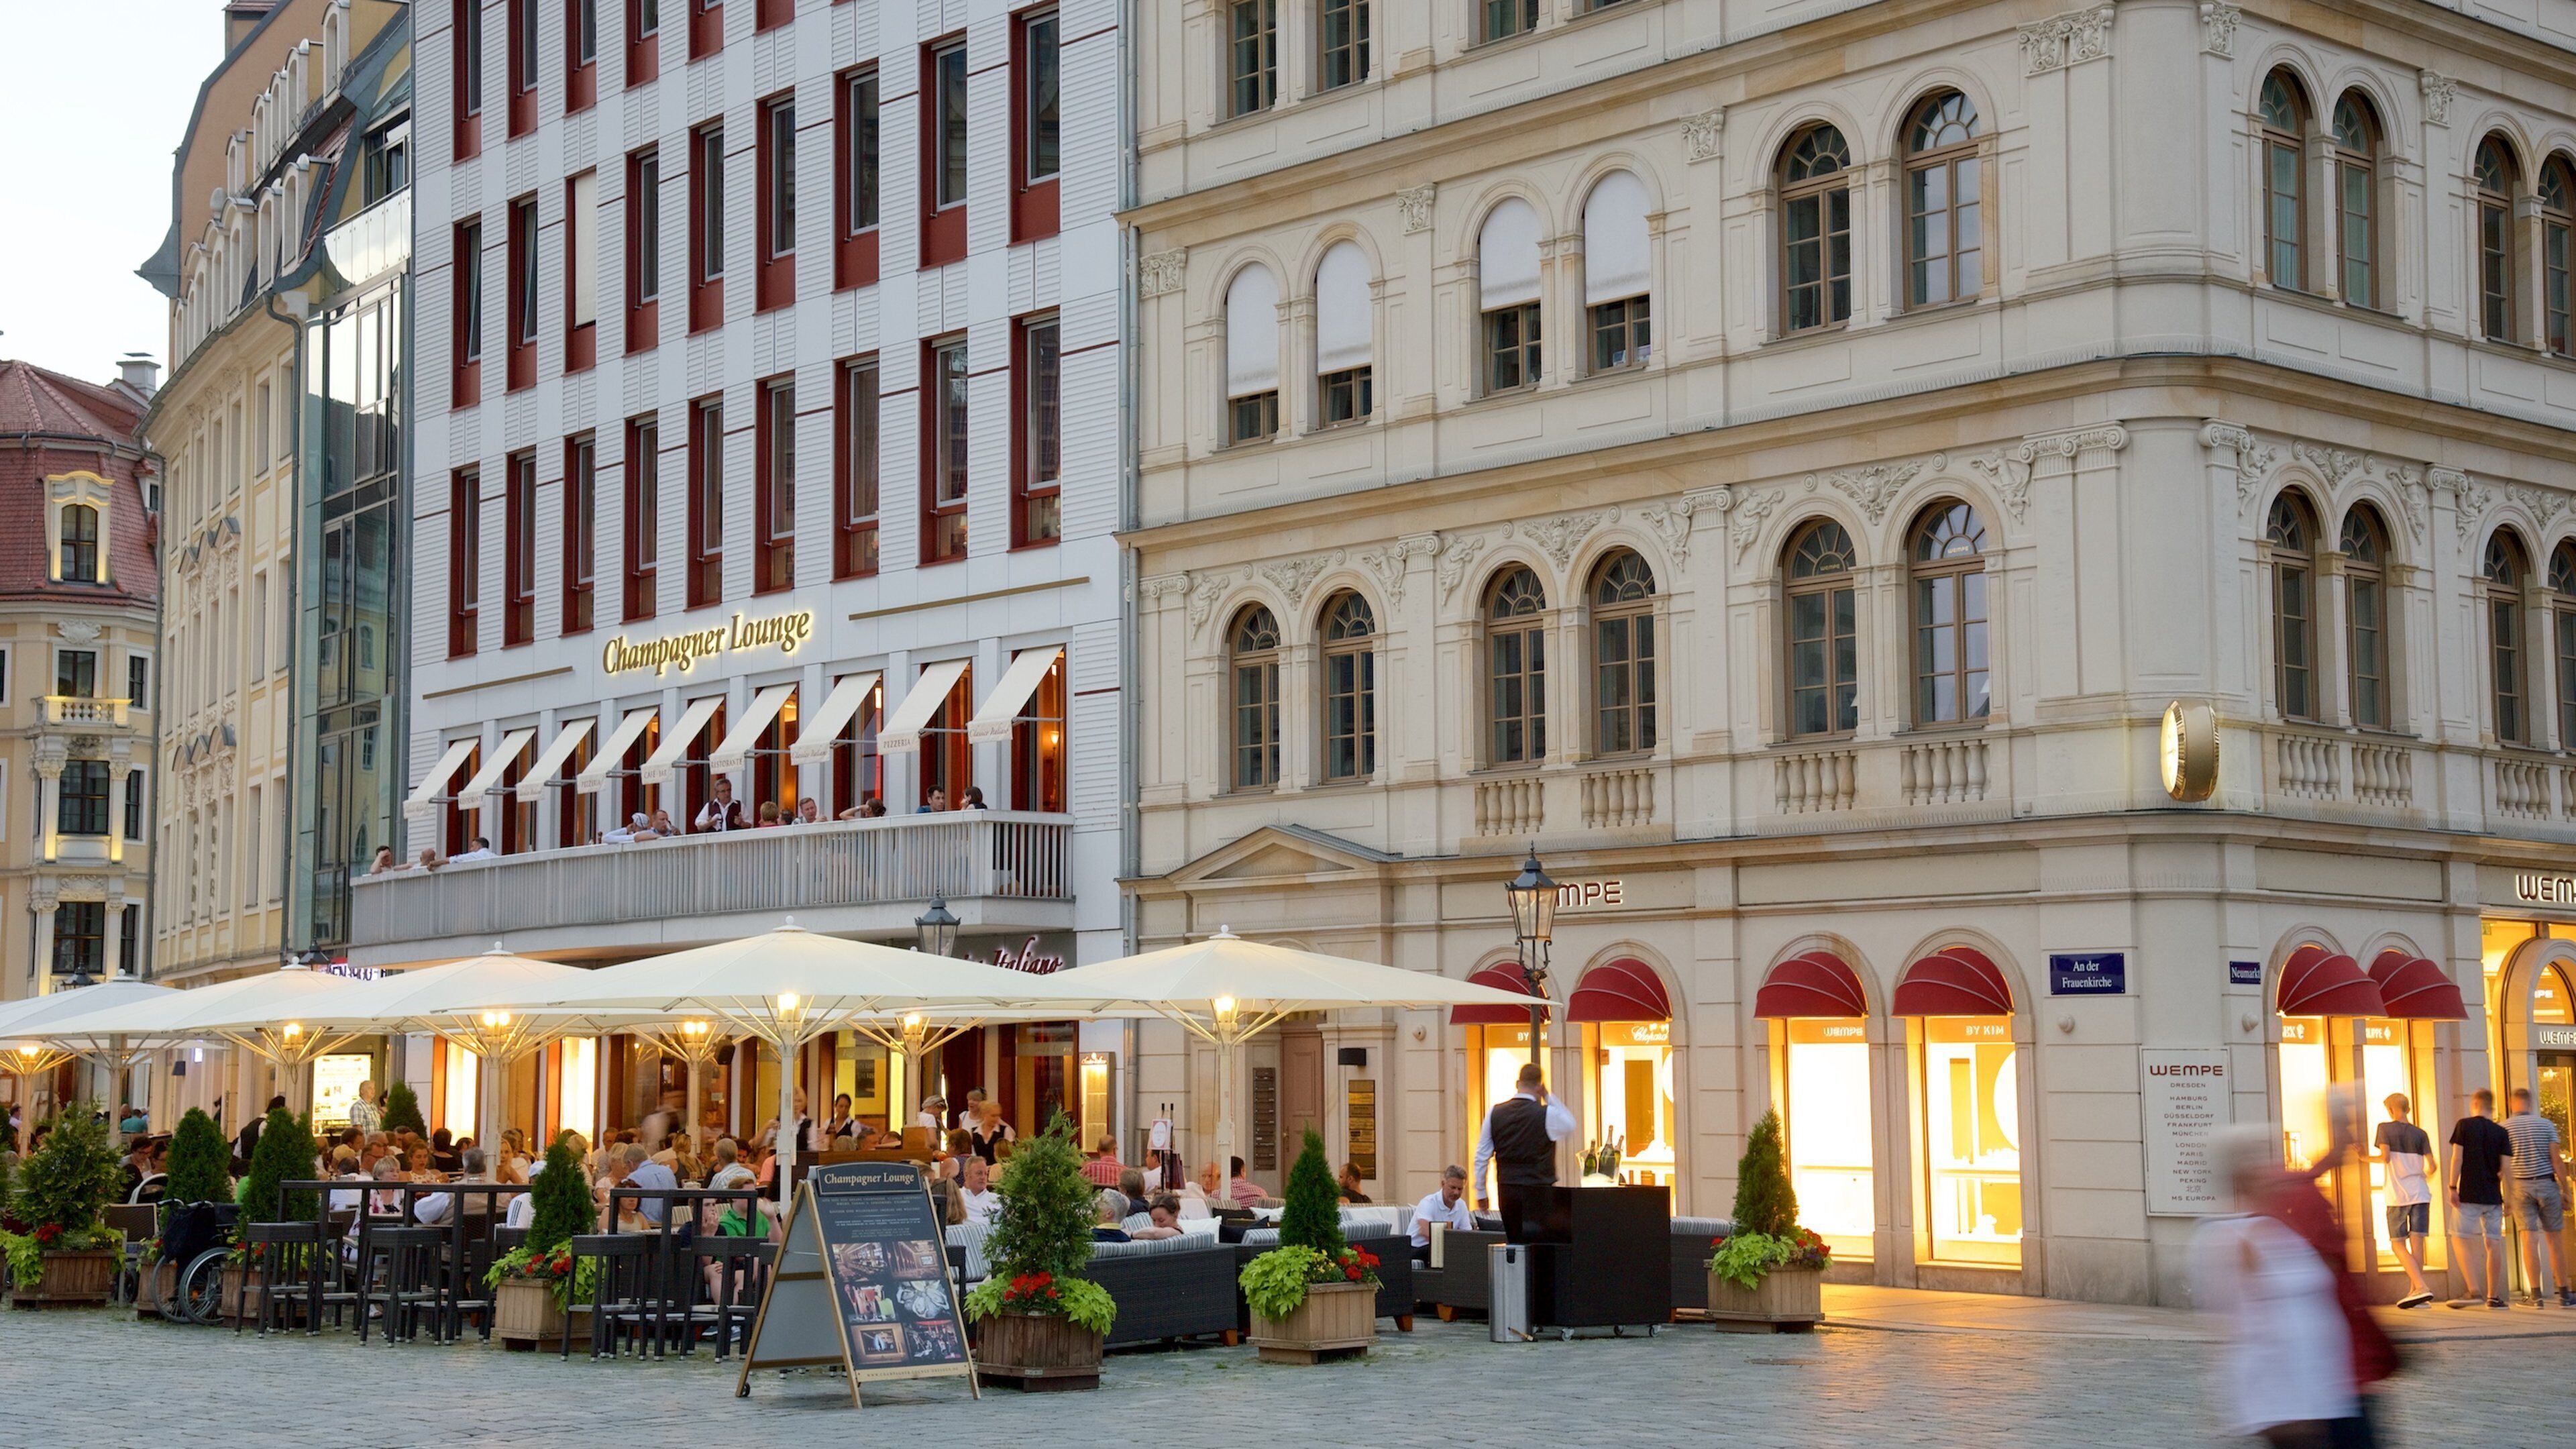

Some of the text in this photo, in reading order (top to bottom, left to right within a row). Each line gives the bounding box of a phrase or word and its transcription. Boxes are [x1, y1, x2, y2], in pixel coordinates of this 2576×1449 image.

[602, 612, 810, 676] Champagner Lounge
[883, 739, 911, 749] PIZZERIA
[711, 758, 743, 769] RISTORANTE
[1556, 880, 1623, 908] MPE
[2516, 874, 2576, 904] WEM
[2073, 961, 2100, 971] An der
[2231, 967, 2261, 979] Neumarkt
[2061, 976, 2112, 988] Frauenkirche
[1823, 1027, 1864, 1036] WEMPE
[1965, 1026, 2004, 1035] BY KIM
[1517, 1032, 1529, 1041] BY
[2149, 1065, 2223, 1076] WEMPE
[824, 1172, 915, 1186] Champagner Lounge
[2186, 1185, 2202, 1193] 北京
